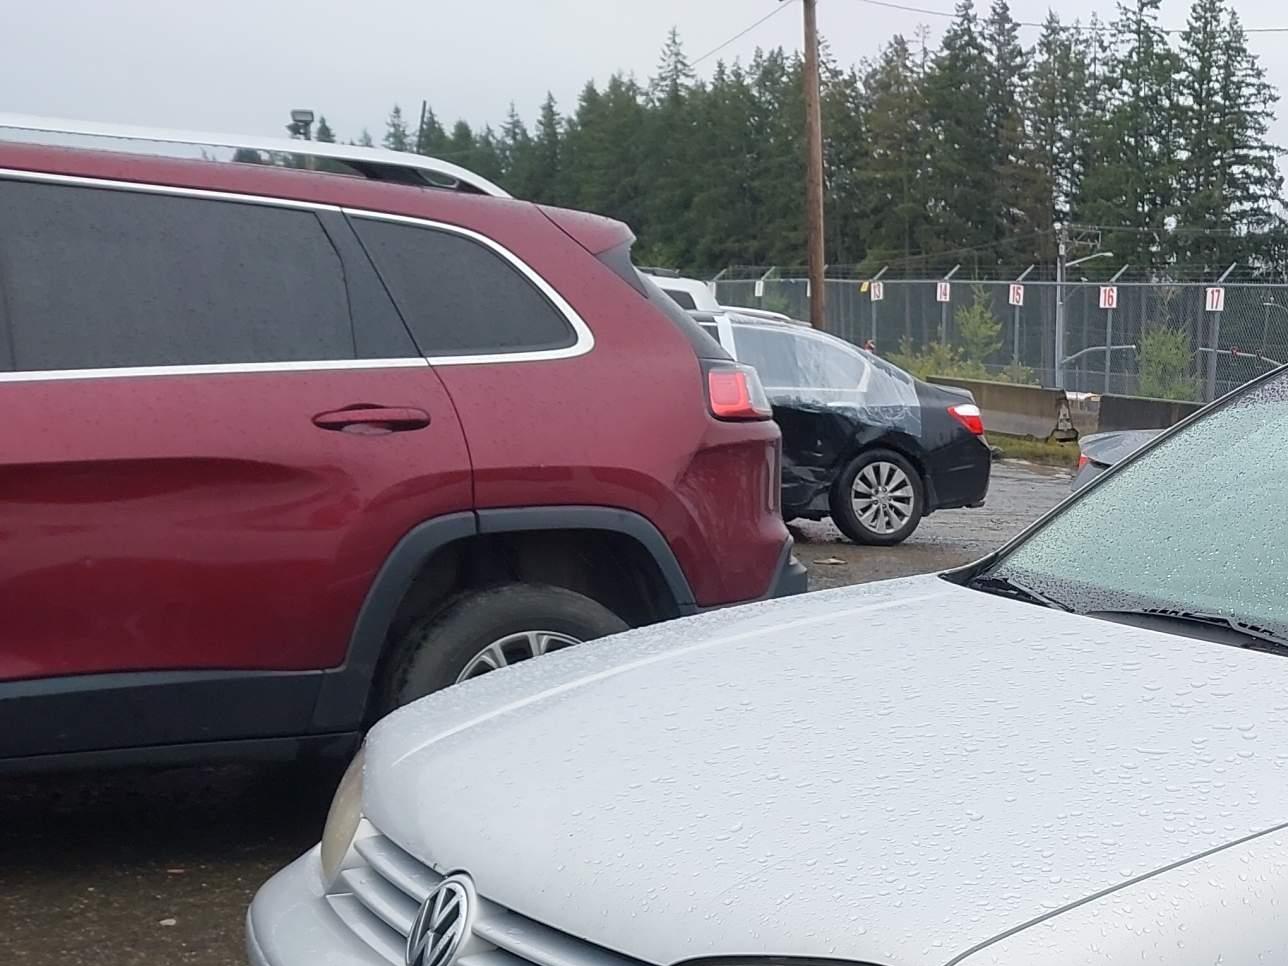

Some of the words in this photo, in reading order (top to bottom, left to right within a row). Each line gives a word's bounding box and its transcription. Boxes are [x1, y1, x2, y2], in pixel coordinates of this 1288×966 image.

[1012, 286, 1021, 304] 15
[1103, 289, 1114, 306] 16
[1210, 289, 1221, 309] 17
